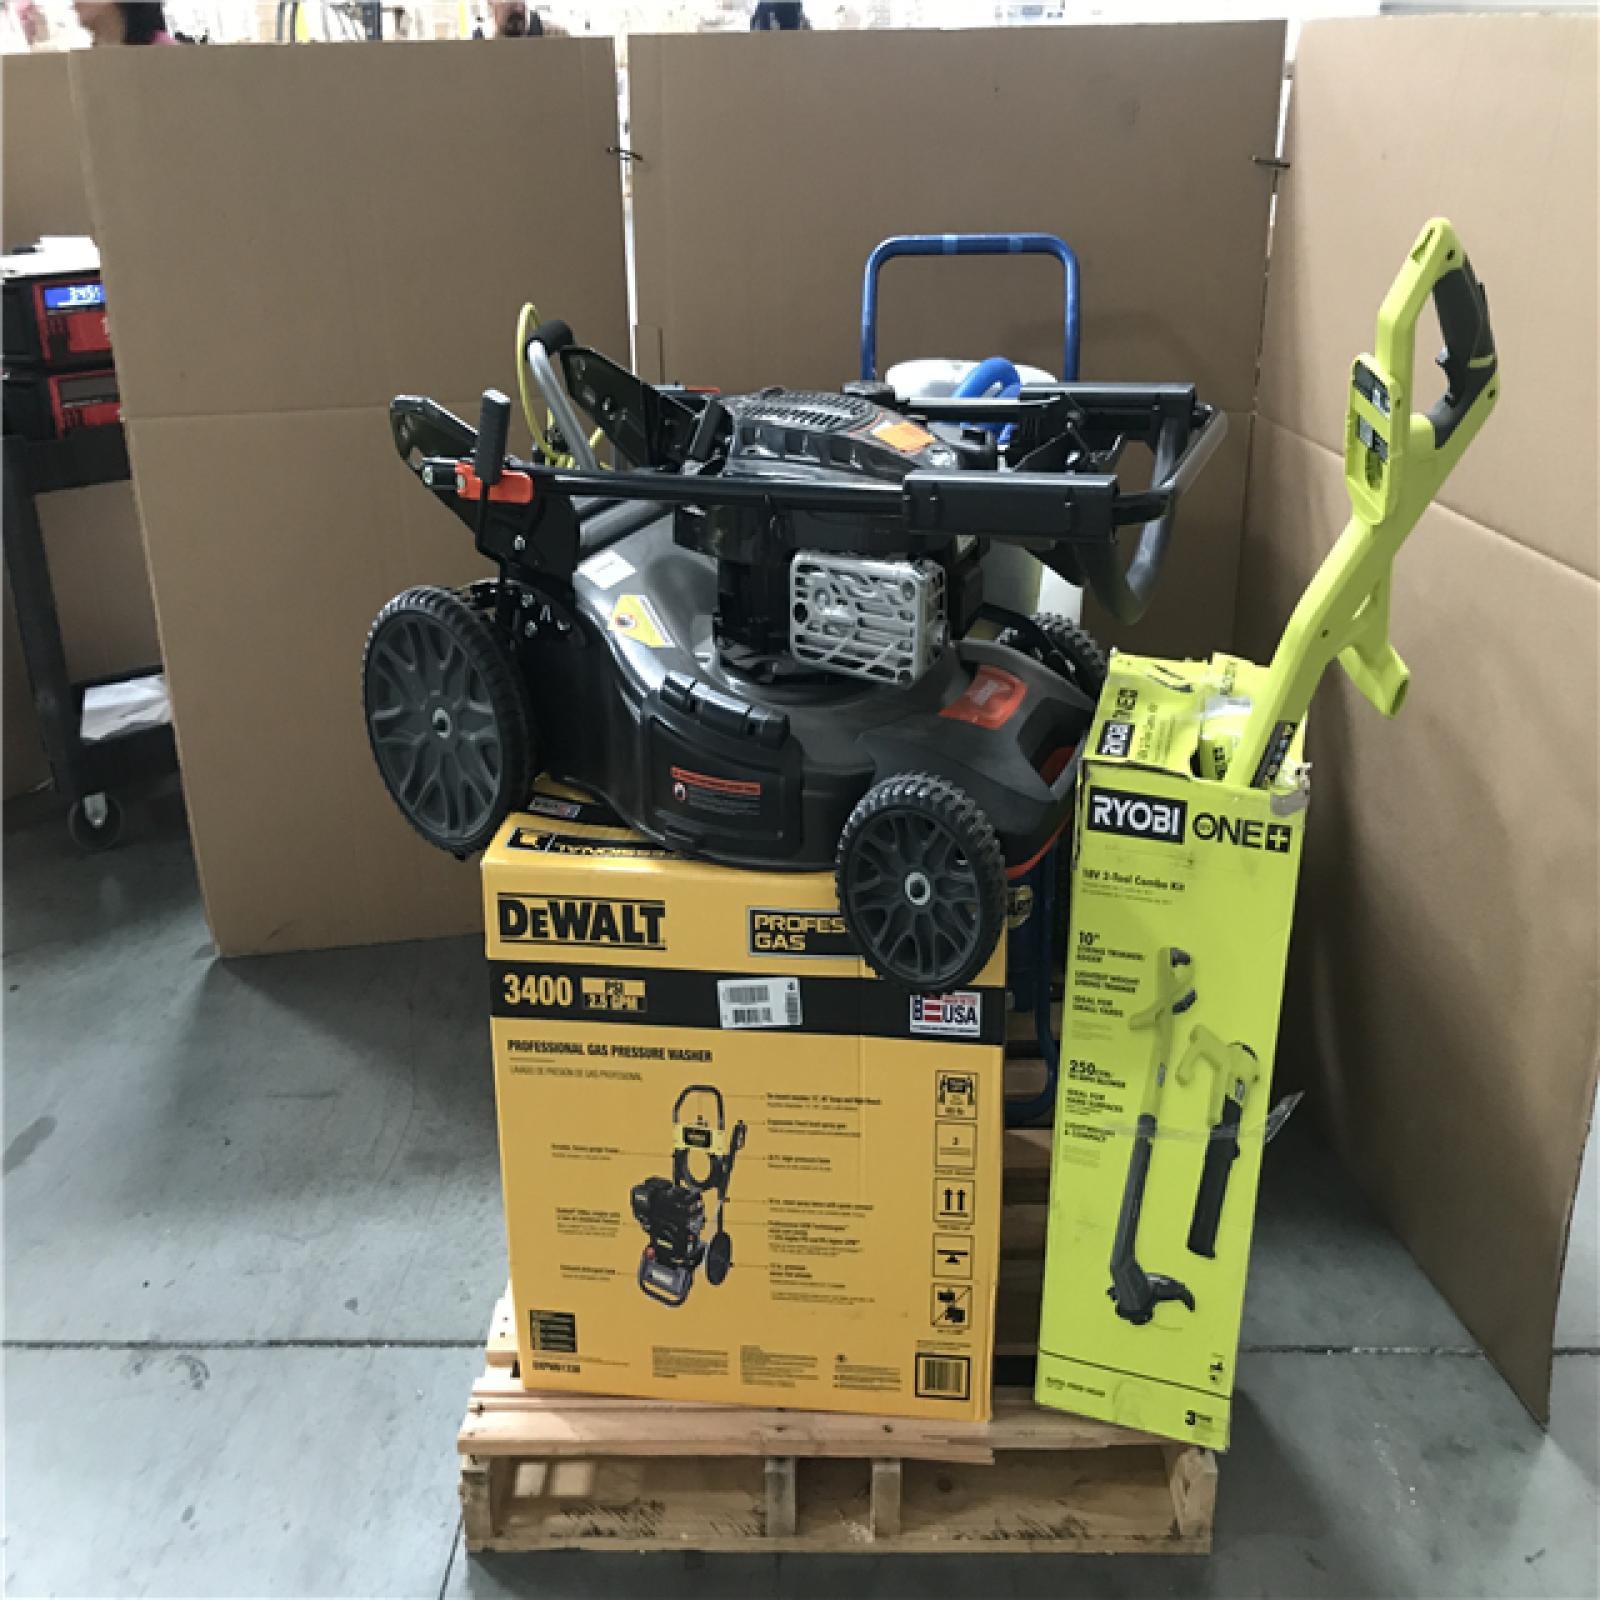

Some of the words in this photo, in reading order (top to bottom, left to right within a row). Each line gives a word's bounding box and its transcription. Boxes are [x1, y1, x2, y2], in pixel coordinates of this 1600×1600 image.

[1091, 794, 1182, 837] RYOBI
[754, 932, 806, 951] GAS
[503, 973, 573, 1007] 3400
[943, 1004, 978, 1025] USA
[506, 1039, 585, 1055] PROFESSIONAL
[611, 1044, 666, 1060] PRESSURE
[667, 1049, 714, 1063] WASHER
